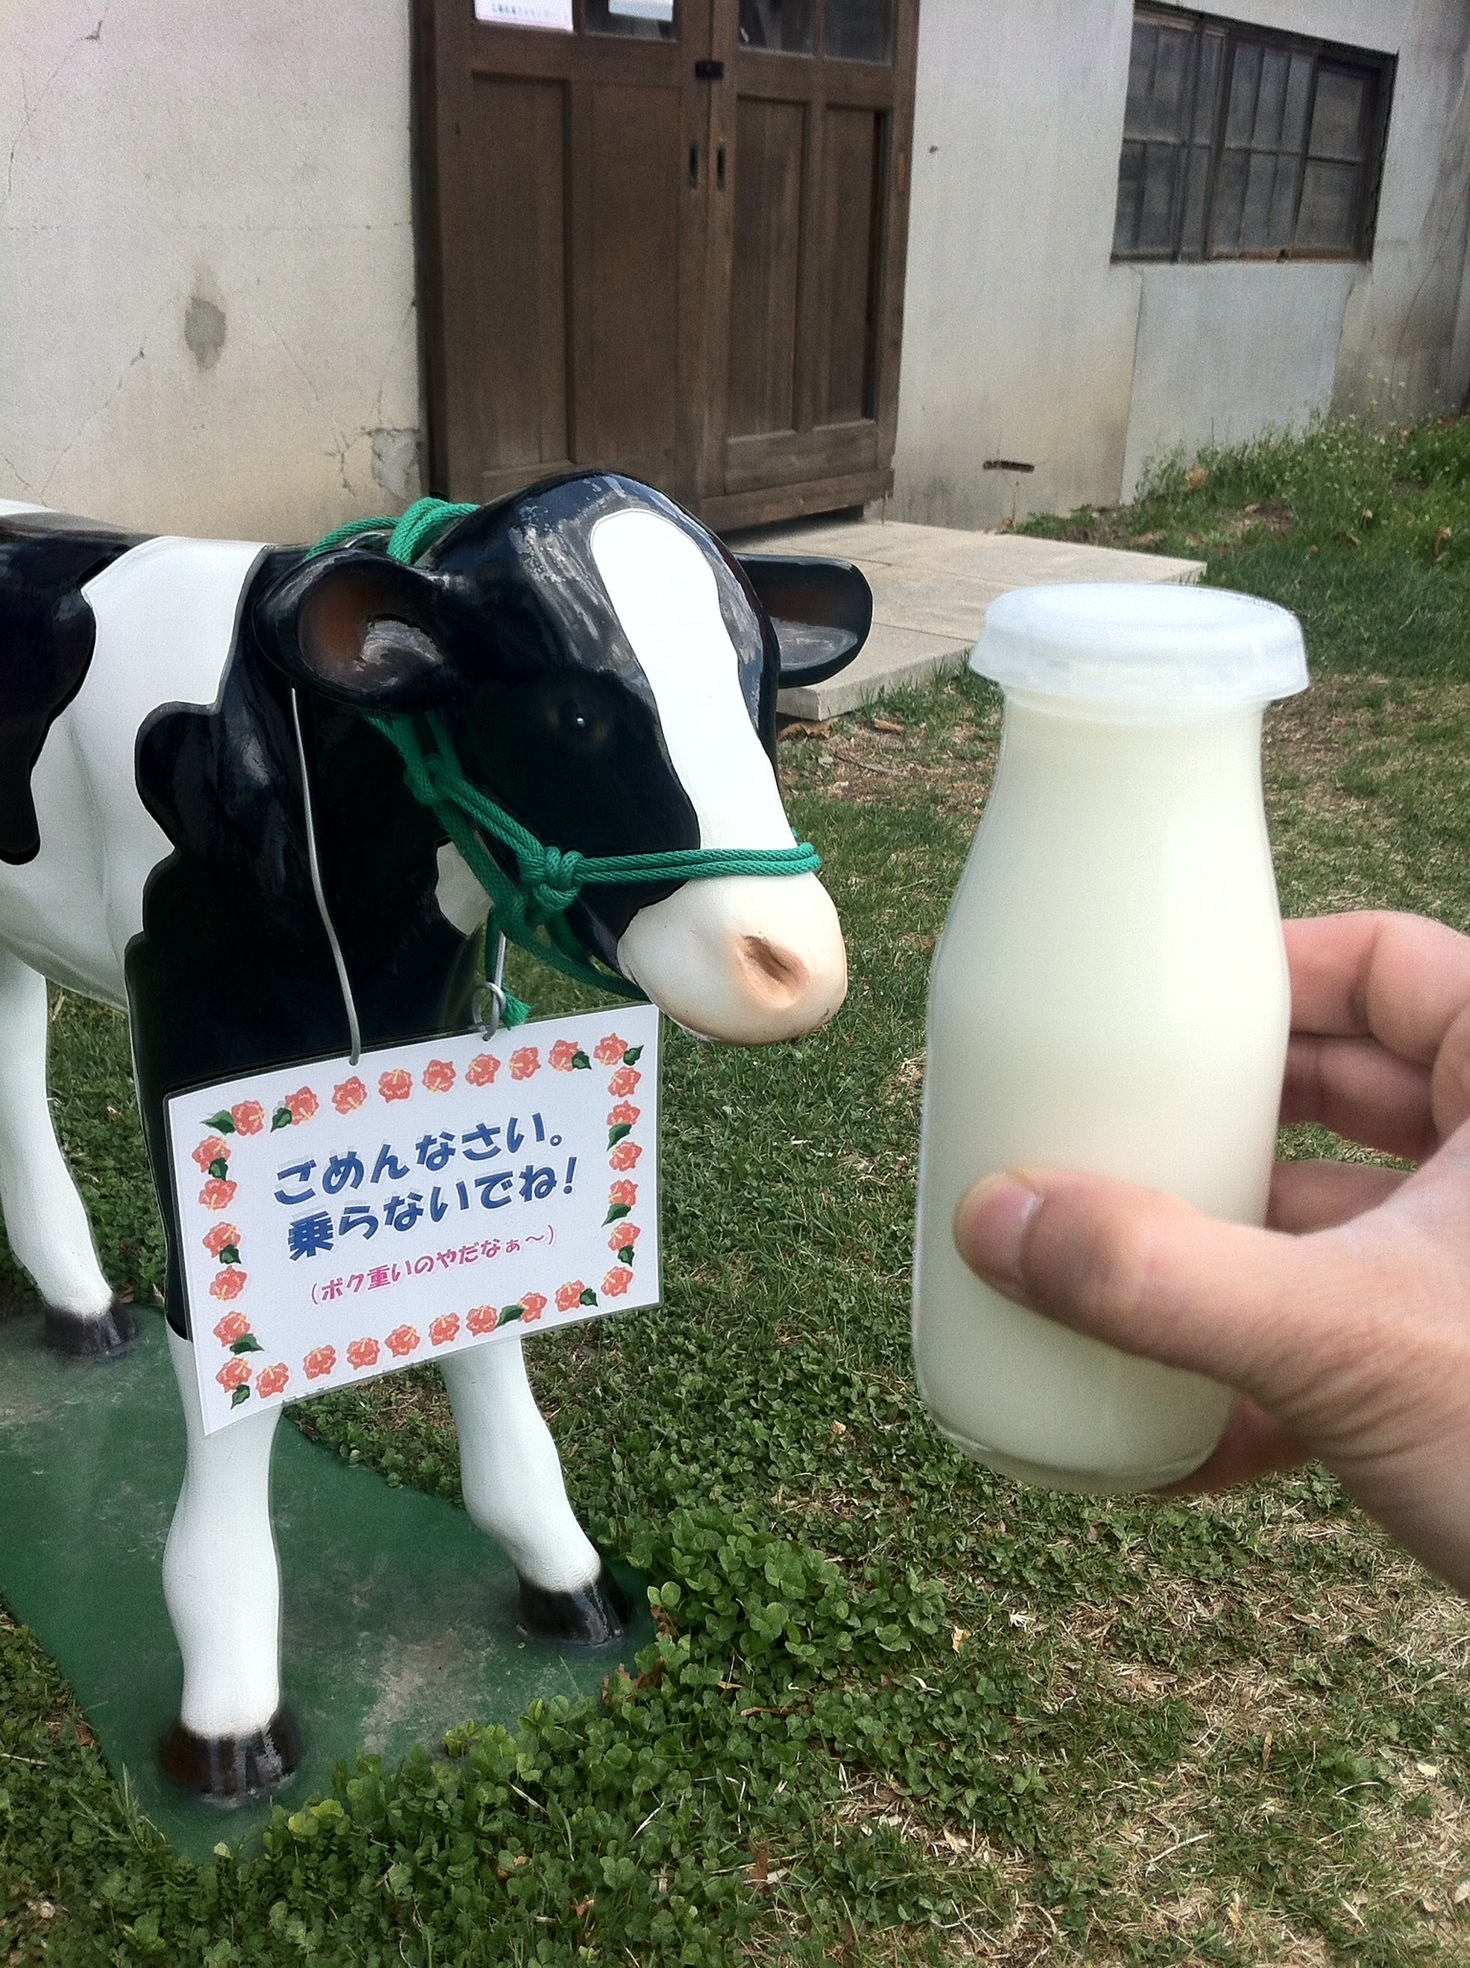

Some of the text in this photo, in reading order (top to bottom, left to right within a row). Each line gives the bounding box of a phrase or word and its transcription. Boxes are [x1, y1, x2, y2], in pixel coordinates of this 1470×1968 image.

[287, 1156, 577, 1262] 乗らないでね!
